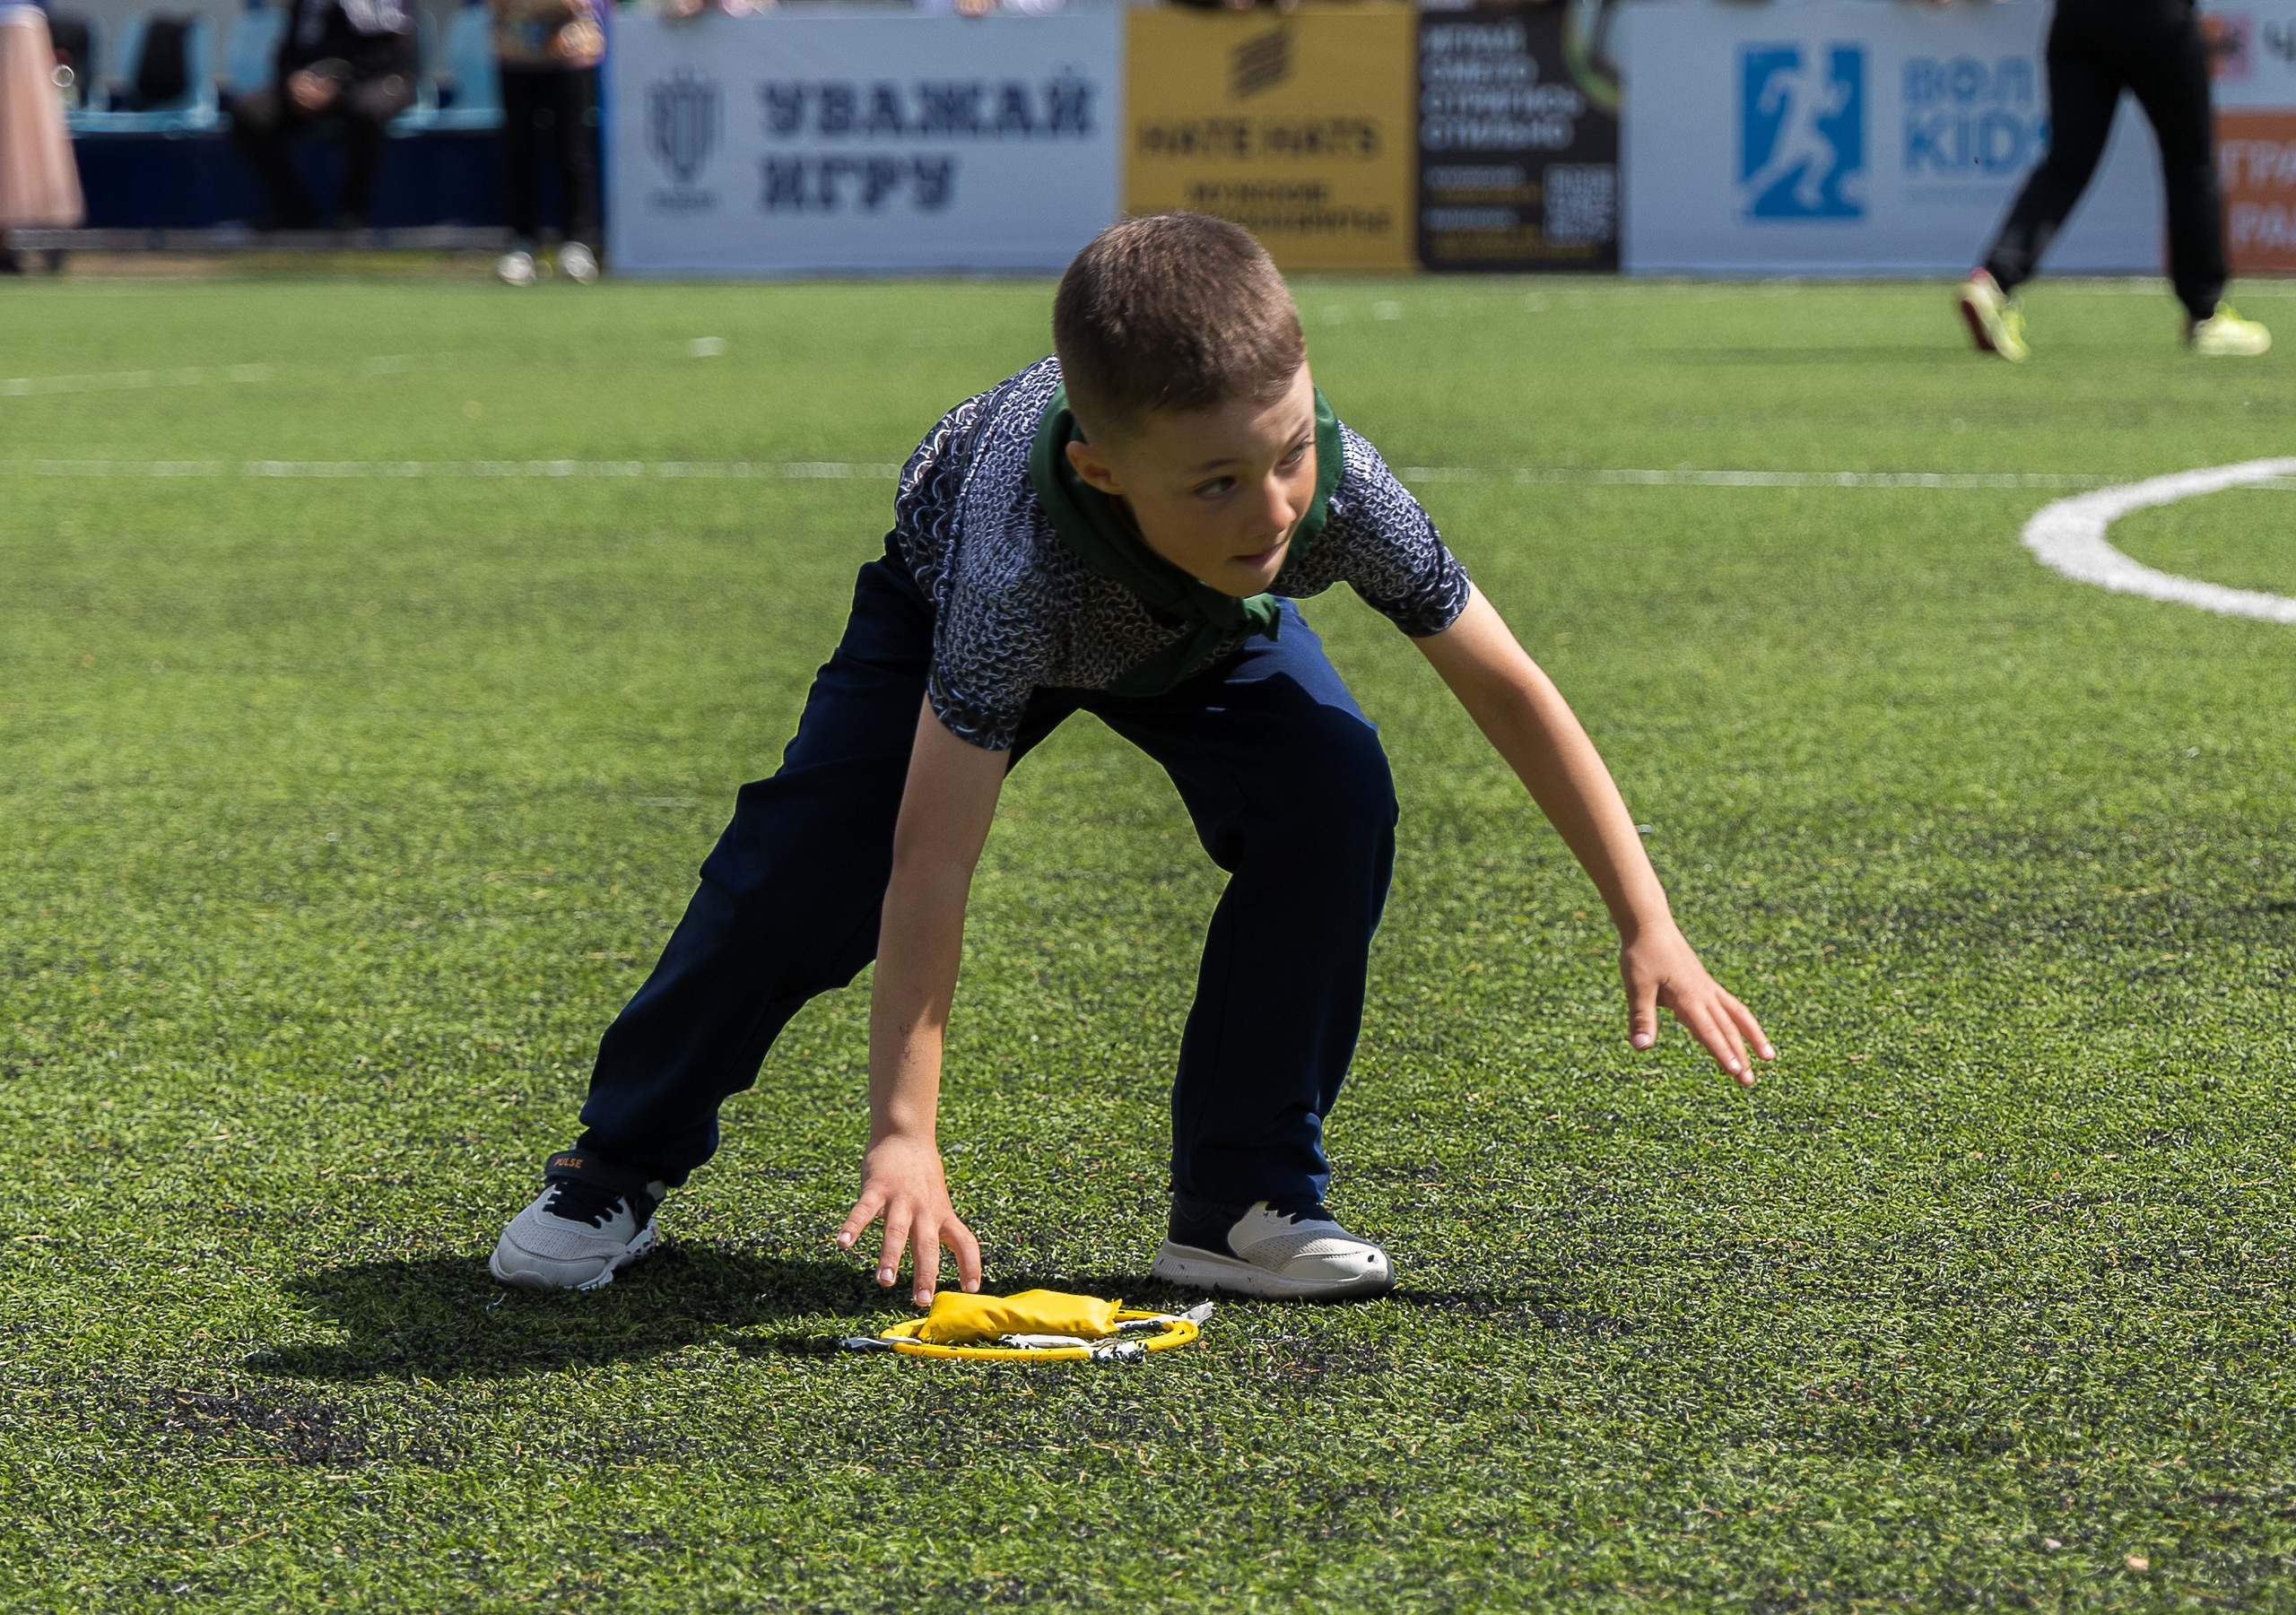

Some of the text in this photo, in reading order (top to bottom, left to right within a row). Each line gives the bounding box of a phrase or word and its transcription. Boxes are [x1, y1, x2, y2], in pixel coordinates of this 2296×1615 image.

[762, 65, 1095, 137] УВАЖАЙ
[762, 155, 956, 212] ИГРУ
[554, 1159, 583, 1168] PULSE
